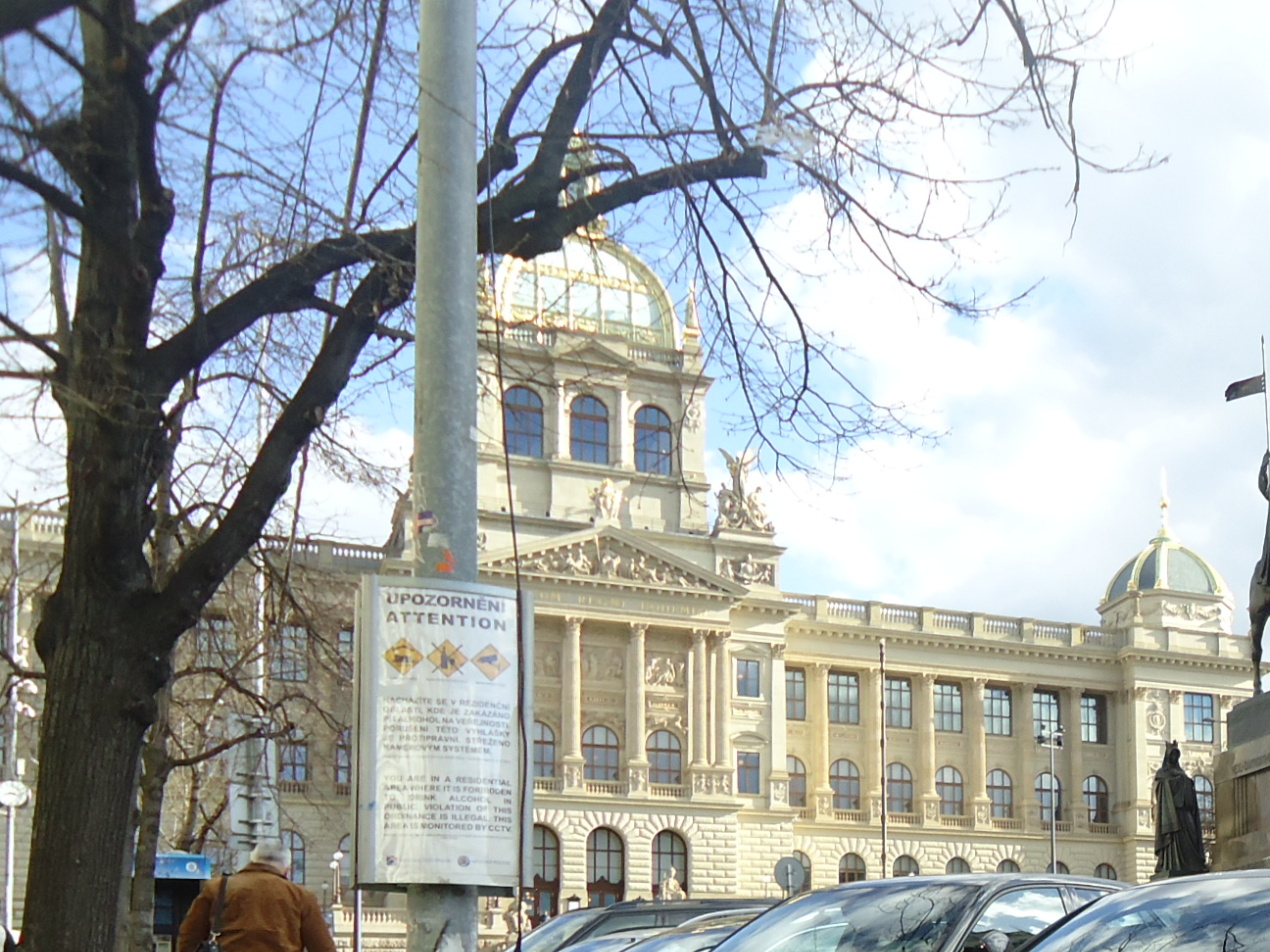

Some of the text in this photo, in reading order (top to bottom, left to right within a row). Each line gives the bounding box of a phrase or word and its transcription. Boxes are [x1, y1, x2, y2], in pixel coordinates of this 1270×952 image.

[387, 592, 506, 613] UPOZORNĚNÍ
[386, 611, 506, 631] ATTENTION
[456, 776, 511, 786] RESIDENTIAL
[449, 795, 491, 804] ALCOHOL
[494, 806, 512, 814] THIS
[494, 815, 512, 823] THIS
[475, 823, 486, 831] BY
